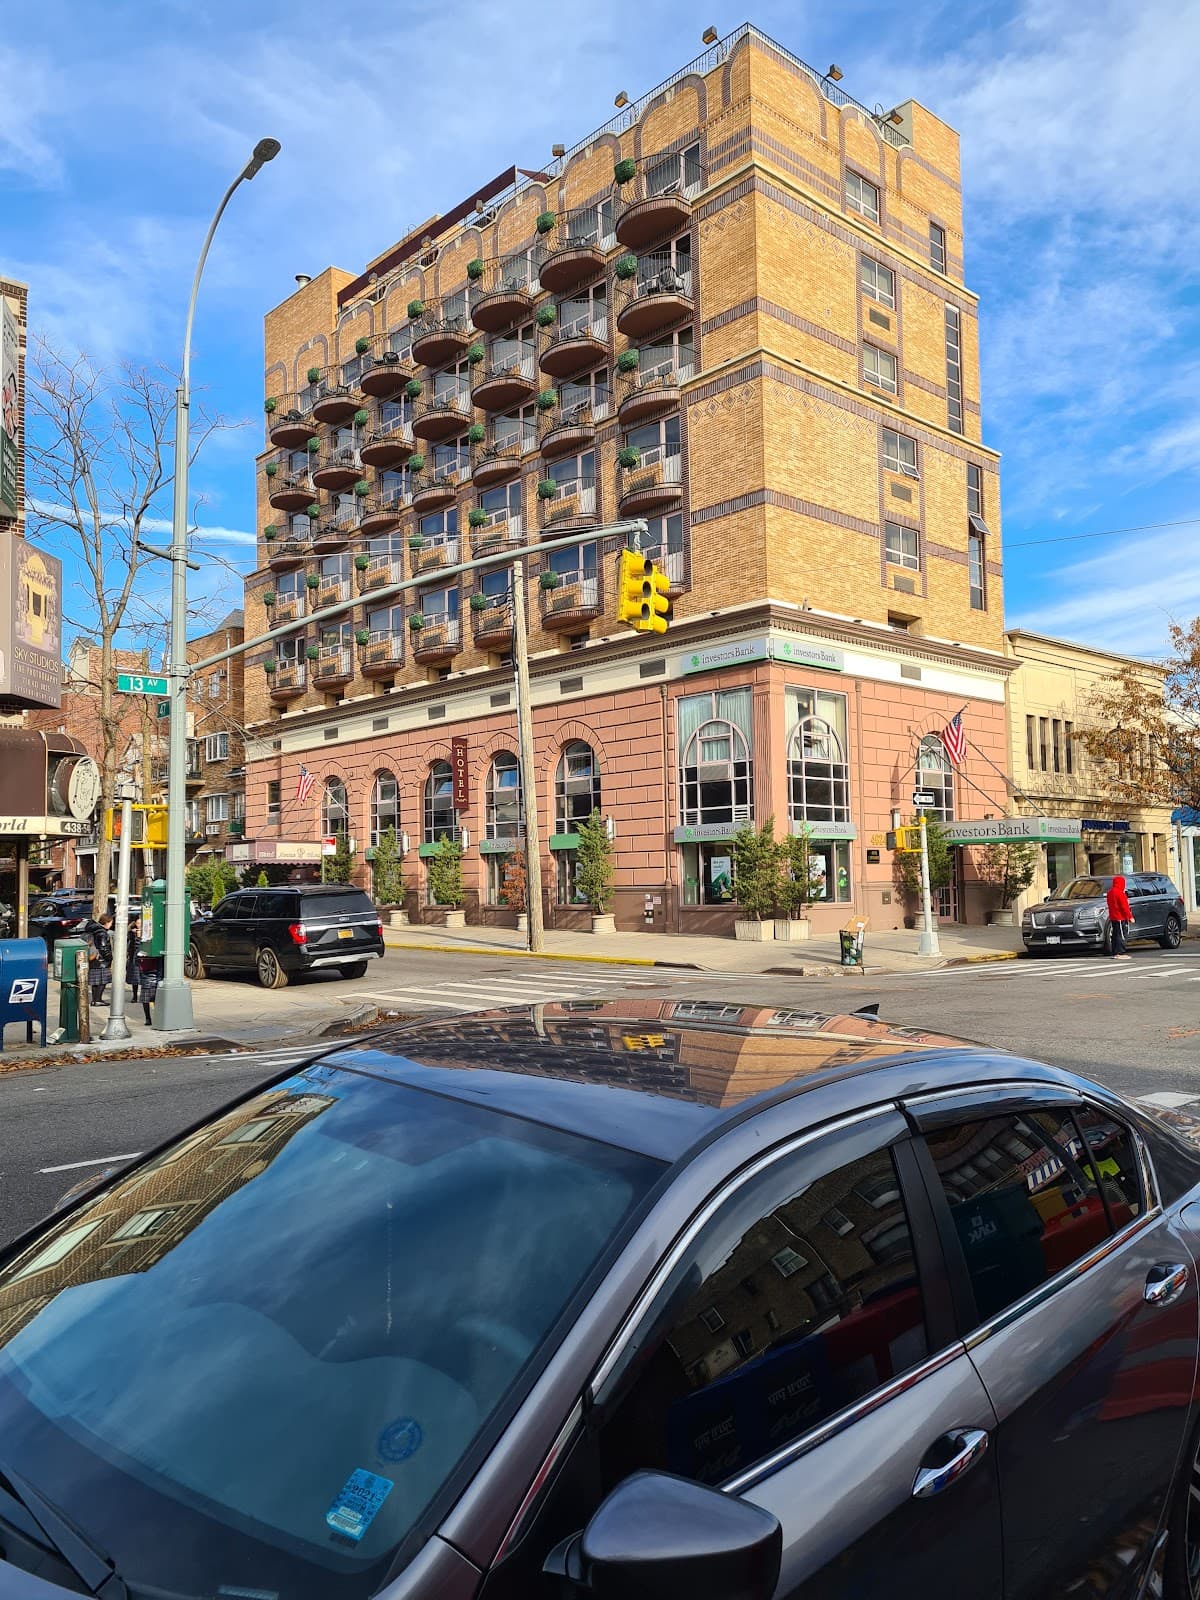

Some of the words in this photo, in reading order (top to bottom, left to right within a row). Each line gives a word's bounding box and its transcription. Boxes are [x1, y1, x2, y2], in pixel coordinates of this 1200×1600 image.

[14, 646, 28, 661] SKY
[29, 652, 59, 673] STUDIOS
[129, 677, 144, 691] 13
[147, 679, 158, 687] AV
[456, 748, 465, 798] HOTEL
[351, 1484, 378, 1501] 2021
